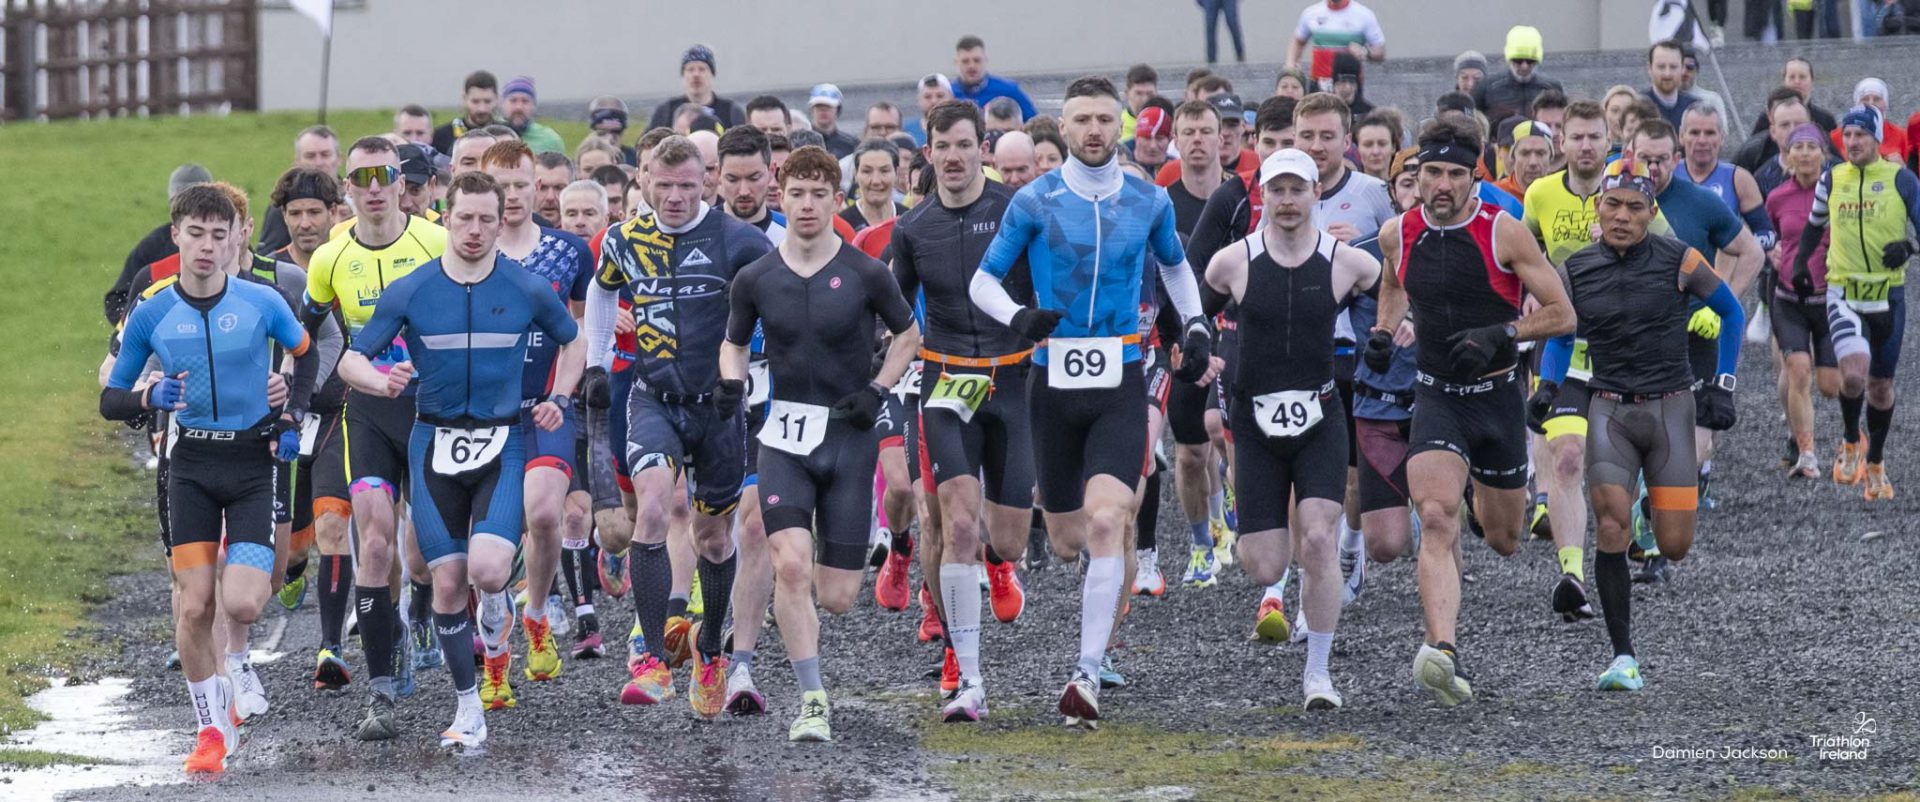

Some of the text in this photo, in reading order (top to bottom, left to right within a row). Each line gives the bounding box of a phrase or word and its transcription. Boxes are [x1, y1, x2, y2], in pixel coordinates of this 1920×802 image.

[973, 220, 996, 232] VELO
[636, 278, 708, 296] Naas
[1847, 277, 1889, 301] 127
[1064, 348, 1106, 377] 69
[779, 412, 807, 442] 11
[1270, 401, 1308, 429] 49
[184, 428, 236, 441] ZONE3
[450, 435, 493, 464] 67
[194, 692, 213, 725] HUUB
